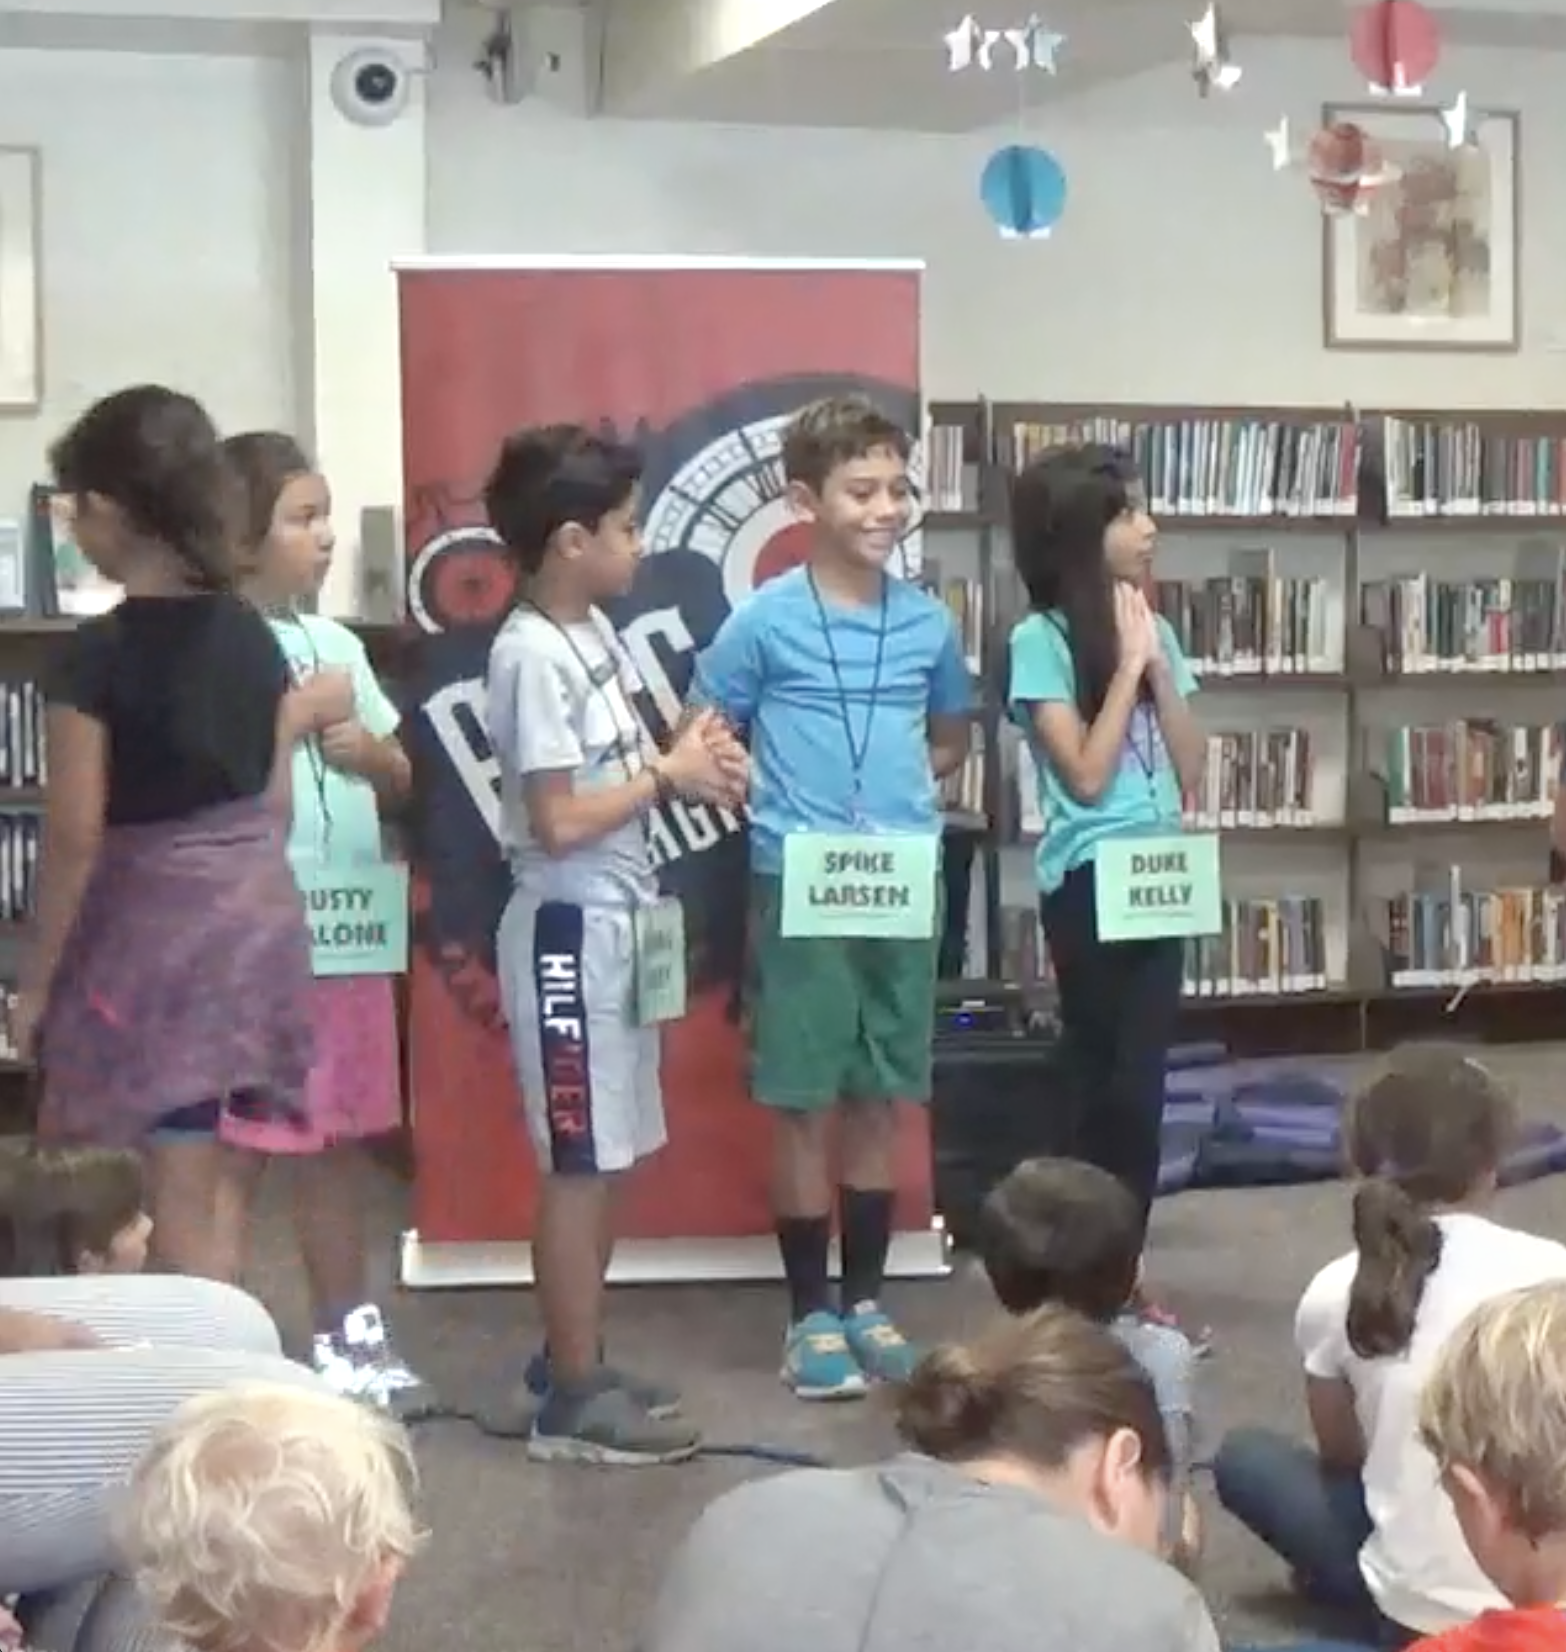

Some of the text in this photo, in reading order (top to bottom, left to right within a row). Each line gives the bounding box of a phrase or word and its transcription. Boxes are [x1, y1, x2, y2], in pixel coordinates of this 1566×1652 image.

[823, 850, 896, 875] SPIKE
[1130, 850, 1189, 875] DUKE
[304, 888, 375, 912] USTY
[807, 884, 910, 907] LARSEN
[1128, 882, 1194, 908] KELLY
